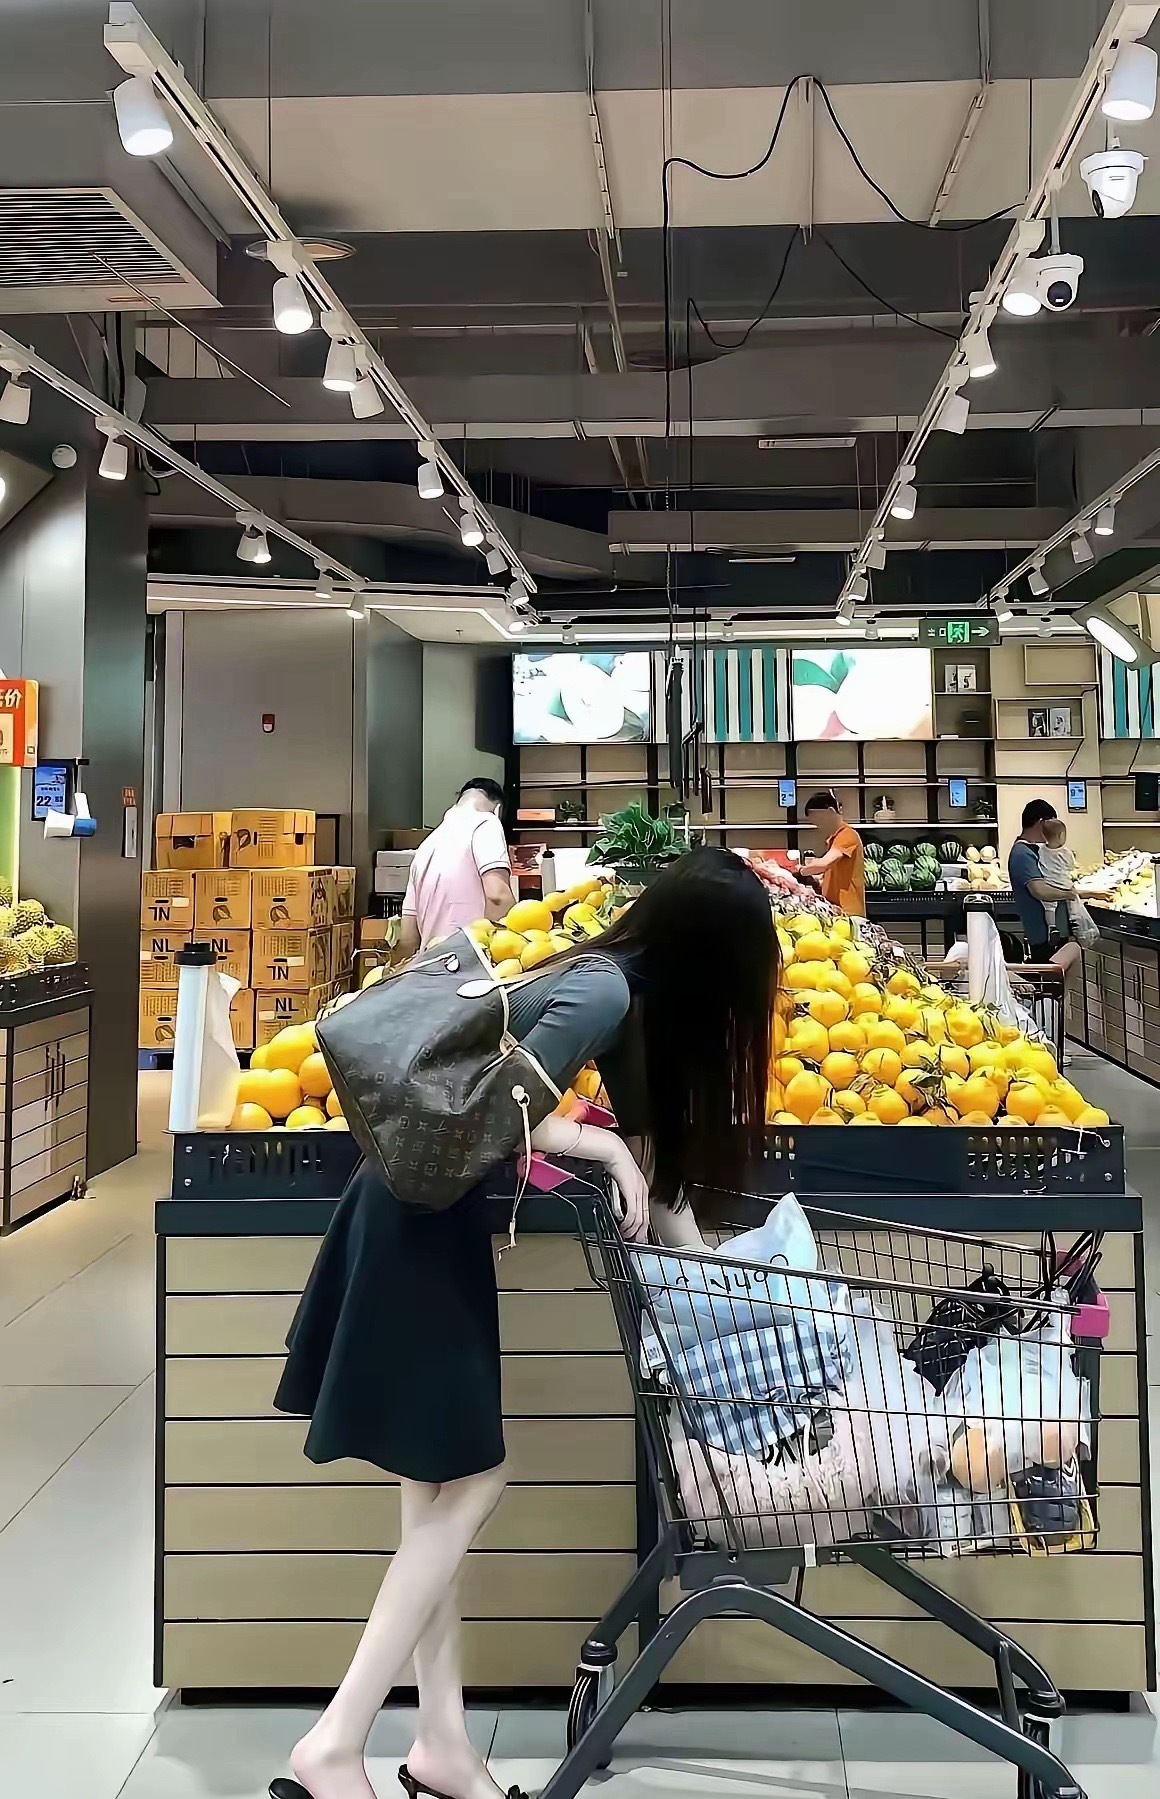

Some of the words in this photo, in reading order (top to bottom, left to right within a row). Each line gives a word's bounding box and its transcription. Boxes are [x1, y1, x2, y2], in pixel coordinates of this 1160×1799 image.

[36, 795, 51, 807] 22
[152, 938, 175, 953] NL
[211, 938, 234, 953] NL
[275, 997, 299, 1012] NL
